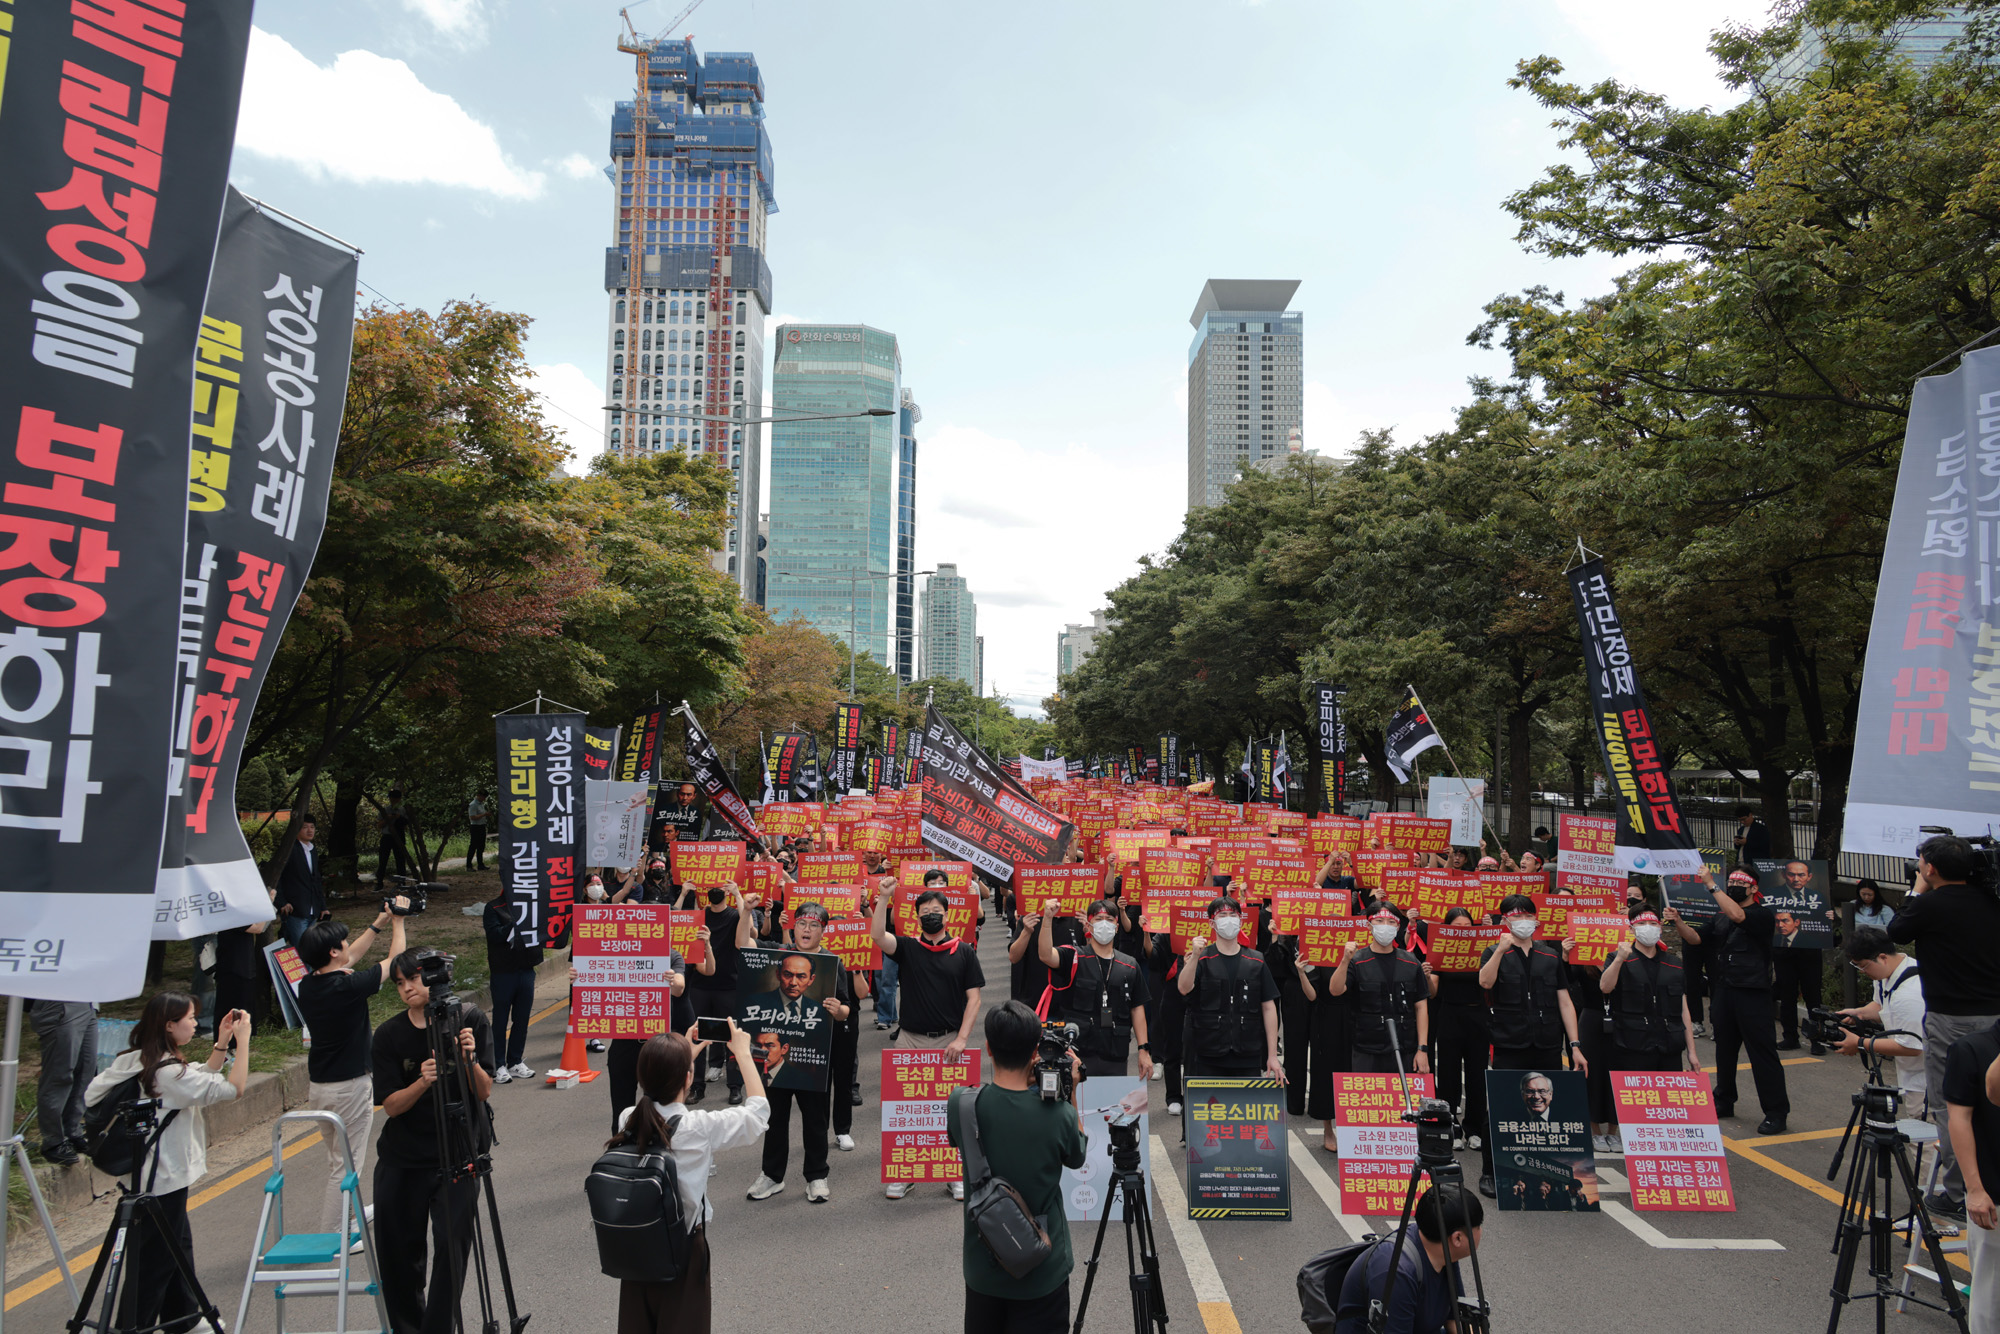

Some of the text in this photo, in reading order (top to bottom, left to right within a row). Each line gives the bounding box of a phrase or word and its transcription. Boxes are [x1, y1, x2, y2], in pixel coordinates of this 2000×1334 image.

[803, 332, 861, 342] 한화 손해보험
[251, 273, 323, 541] 성공사례
[0, 405, 125, 843] 보장하라
[1590, 574, 1680, 834] 국민경제 퇴보한다
[1320, 690, 1334, 753] 모피아의
[928, 724, 972, 759] 금소원
[779, 736, 799, 784] 미래없는
[1261, 748, 1270, 797] 쪼개지는
[510, 739, 537, 828] 분리형
[922, 746, 970, 782] 공공기관
[969, 777, 996, 799] 지정
[1000, 794, 1056, 834] 철회하라!
[764, 813, 807, 824] 금융소비자
[922, 776, 1048, 856] 융소비자 피해 초래하는
[1461, 803, 1469, 839] 끊어버리자
[958, 816, 987, 843] 해체
[1312, 830, 1341, 840] 금소원
[1394, 828, 1447, 839] 금소원 분리
[546, 726, 577, 948] 성공사례 전무하
[922, 826, 1010, 878] 금융감독원 12기 일동
[676, 855, 739, 868] 금소원 분리
[1145, 860, 1201, 875] 금소원 분리
[1655, 860, 1690, 869] 금융감독원
[802, 864, 859, 877] 금감원 독립성
[1250, 868, 1311, 883] 금융소비자
[1022, 880, 1098, 895] 금소원 분리
[1418, 887, 1458, 904] 금소원
[1762, 894, 1822, 910] 모피아의 봄
[586, 910, 656, 920] IMF가 요구하는
[1278, 901, 1346, 916] 금소원 분리
[1419, 904, 1449, 919] 결사
[1305, 918, 1354, 927] 금융소비자보호
[1573, 916, 1623, 925] 금융소비자보호
[579, 924, 664, 938] 금감원 독립성
[1175, 922, 1212, 937] 금감원
[1439, 928, 1476, 937] 국제기준에
[1575, 927, 1619, 944] 금소원
[1305, 930, 1349, 945] 금소원
[600, 940, 642, 952] 보장하라
[1432, 938, 1470, 954] 금감원
[1308, 948, 1338, 963] 결사
[1578, 946, 1608, 961] 결사
[589, 960, 654, 970] 영국도 반성했다
[578, 973, 664, 983] 쌍봉형 체계 반대한다
[581, 992, 662, 1002] 임원 자리는 증가!
[581, 1006, 662, 1016] 감독 효율은 감소!
[742, 1006, 822, 1029] 모피아의 봄
[578, 1019, 666, 1033] 금소원 분리 반대
[892, 1054, 940, 1064] 금융소비자
[896, 1067, 967, 1081] 금소원 분리
[1343, 1077, 1386, 1090] 금융감독
[1624, 1076, 1697, 1088] IMF가 요구하는
[902, 1083, 928, 1097] 결사
[1339, 1093, 1393, 1106] 금융소비자
[1620, 1090, 1708, 1106] 금감원 독립성
[1193, 1104, 1280, 1120] 금융소비자
[1645, 1108, 1688, 1120] 보장하라
[889, 1118, 934, 1127] 금융소비자
[1498, 1122, 1584, 1133] 금융소비자를 위한
[1206, 1125, 1269, 1139] 경보 발령
[1358, 1131, 1417, 1141] 금소원 분리는
[1636, 1128, 1704, 1138] 영국도 반성했다
[895, 1135, 936, 1145] 실익 없는
[1516, 1134, 1569, 1145] 나라는 없다
[1628, 1141, 1718, 1152] 쌍봉형 체계 반대한다
[1354, 1145, 1372, 1155] 신체
[886, 1164, 925, 1178] 피눈물
[1345, 1163, 1397, 1174] 금융감독기능
[1635, 1160, 1719, 1172] 임원 자리는 증가!
[1345, 1179, 1409, 1193] 금융감독체계
[1637, 1175, 1722, 1187] 감독 효율은 감소!
[1366, 1197, 1388, 1210] 결사
[1636, 1189, 1729, 1206] 금소원 분리 반대
